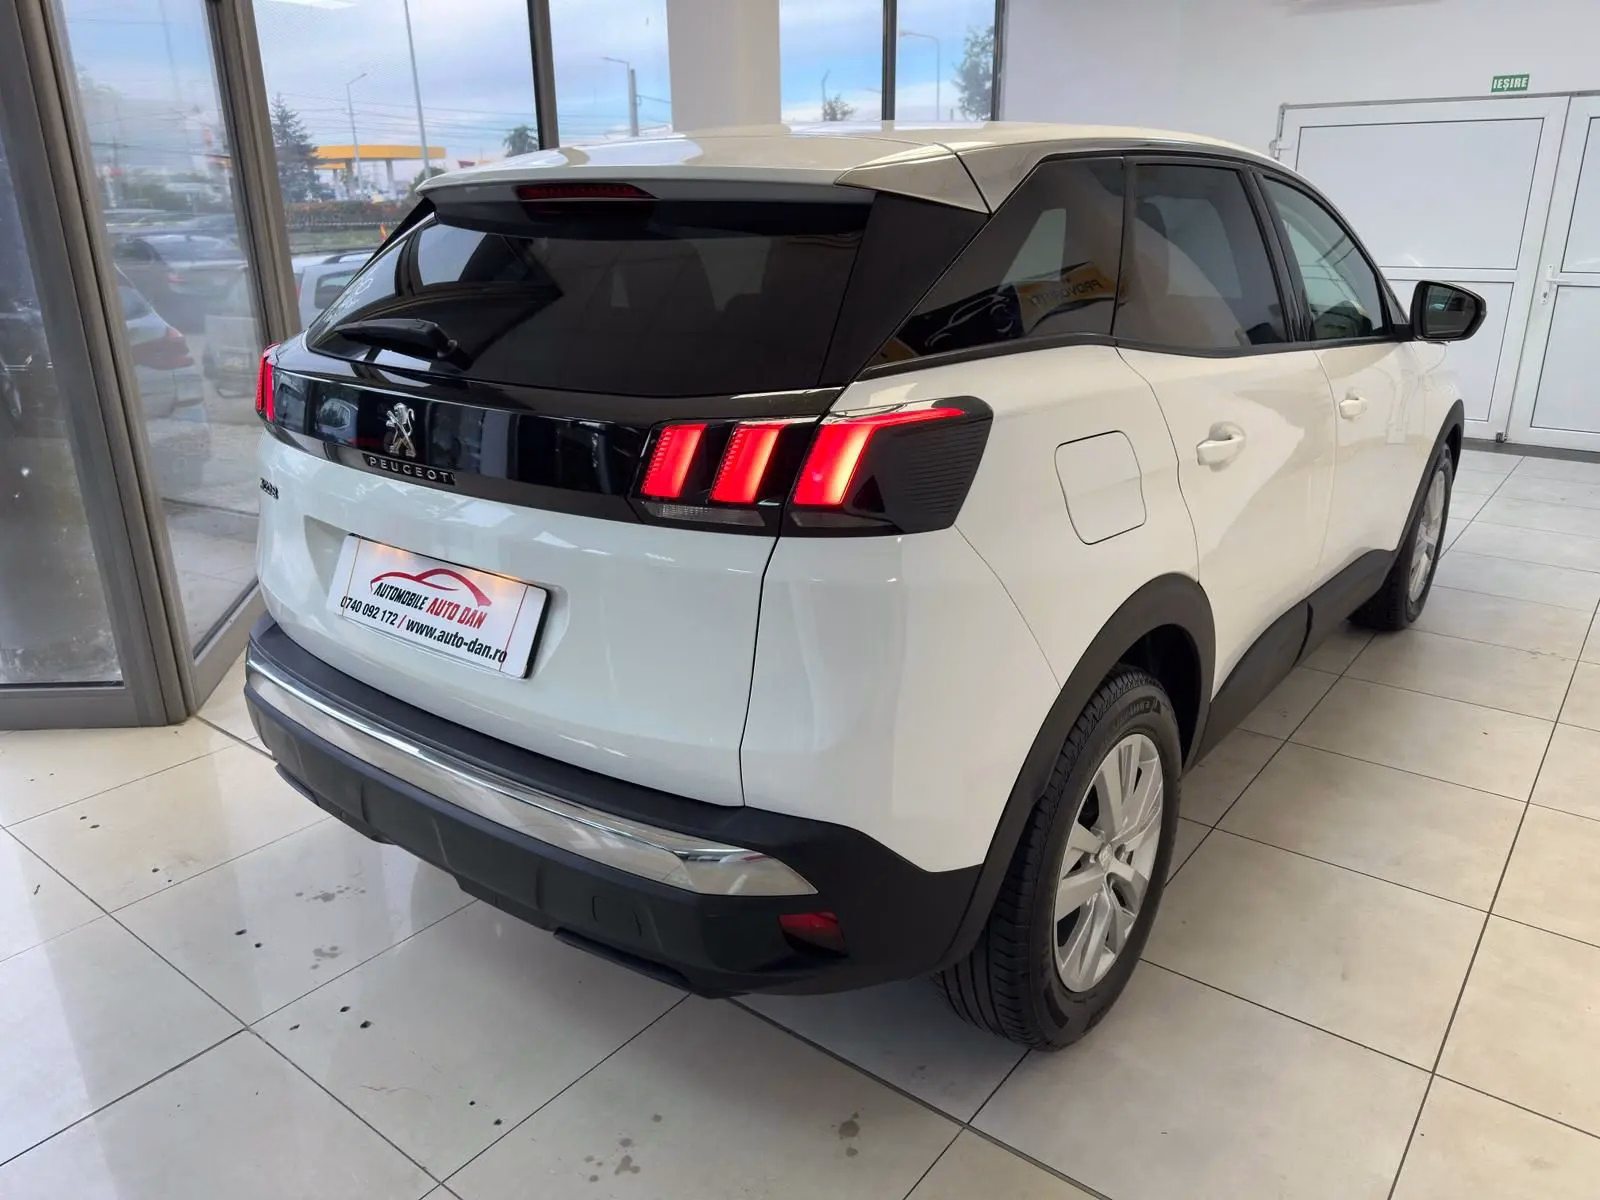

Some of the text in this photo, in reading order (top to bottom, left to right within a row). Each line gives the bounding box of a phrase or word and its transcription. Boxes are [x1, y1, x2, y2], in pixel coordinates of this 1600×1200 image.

[368, 456, 449, 483] PEUGEOT
[373, 582, 488, 629] AUTOMOBILE AUTO DAN
[340, 596, 362, 613] 0740
[362, 603, 380, 620] 092
[380, 609, 399, 626] 172
[405, 618, 508, 664] www.auto-dan.ro
